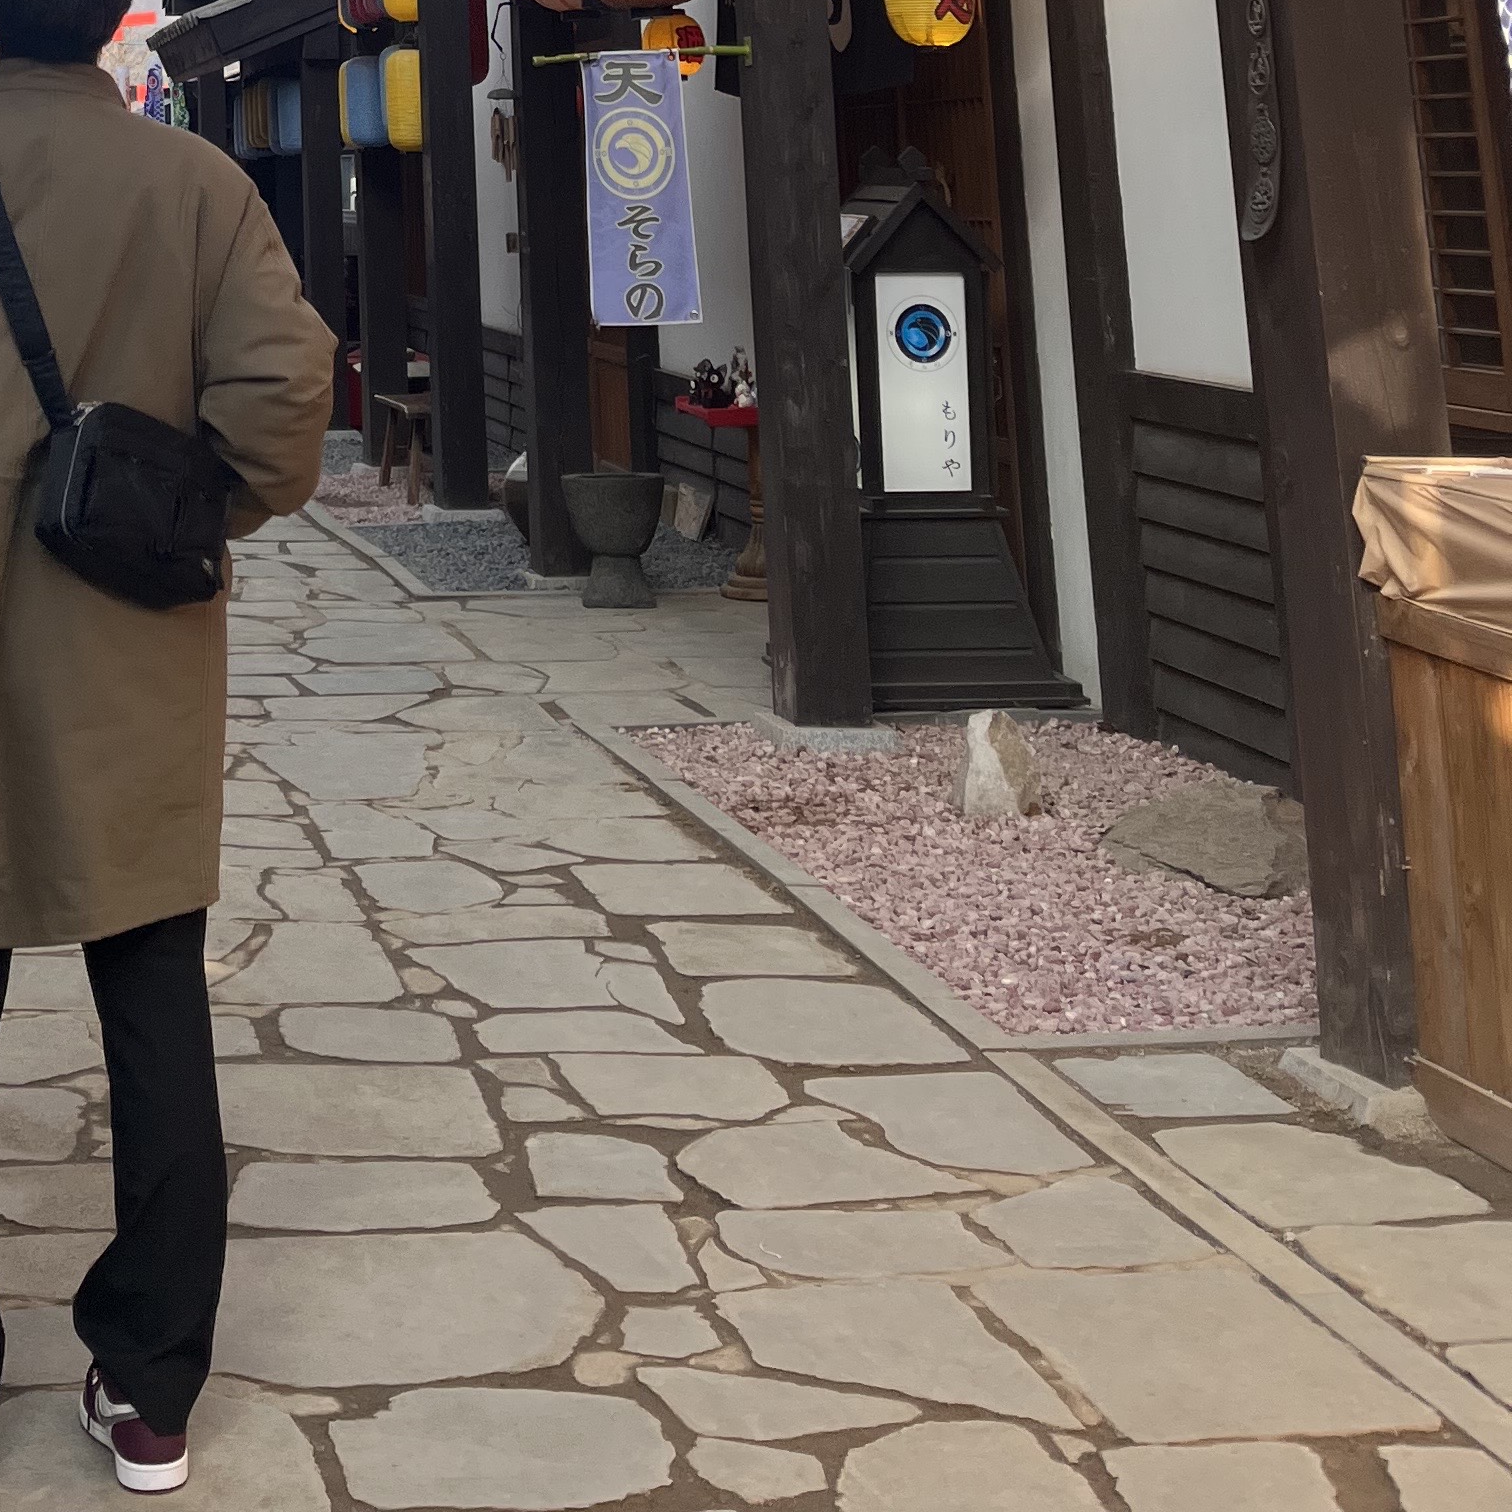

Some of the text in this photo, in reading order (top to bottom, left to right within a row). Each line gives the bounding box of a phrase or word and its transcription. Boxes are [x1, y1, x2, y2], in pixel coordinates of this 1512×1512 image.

[594, 61, 663, 106] 天
[616, 205, 664, 320] そらの
[942, 401, 961, 477] もりや
